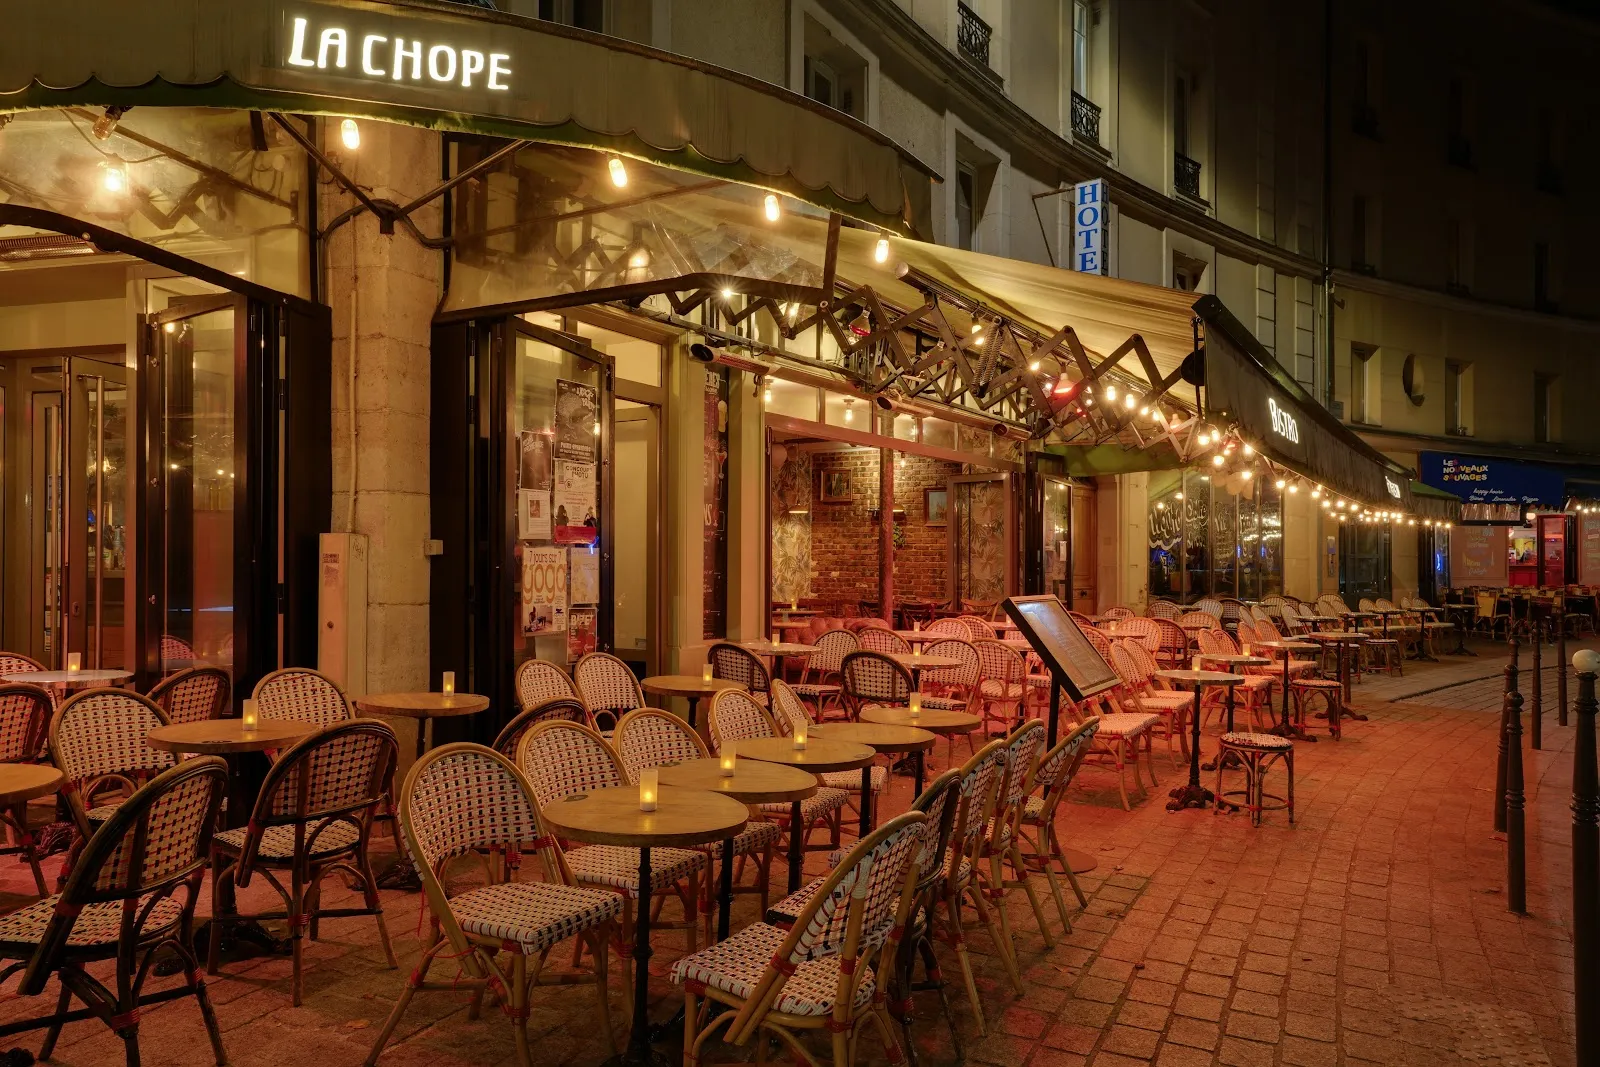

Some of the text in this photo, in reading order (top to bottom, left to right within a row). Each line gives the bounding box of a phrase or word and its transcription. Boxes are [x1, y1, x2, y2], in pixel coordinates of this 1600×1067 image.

[288, 17, 512, 90] LA CHOPE
[1077, 183, 1099, 272] HOTE
[1268, 397, 1299, 444] BISTRO
[1443, 459, 1458, 467] LES
[1443, 465, 1489, 474] NOUVEAUX
[1443, 473, 1488, 482] SAUVAGES
[533, 551, 548, 566] jours
[523, 563, 567, 605] yoga
